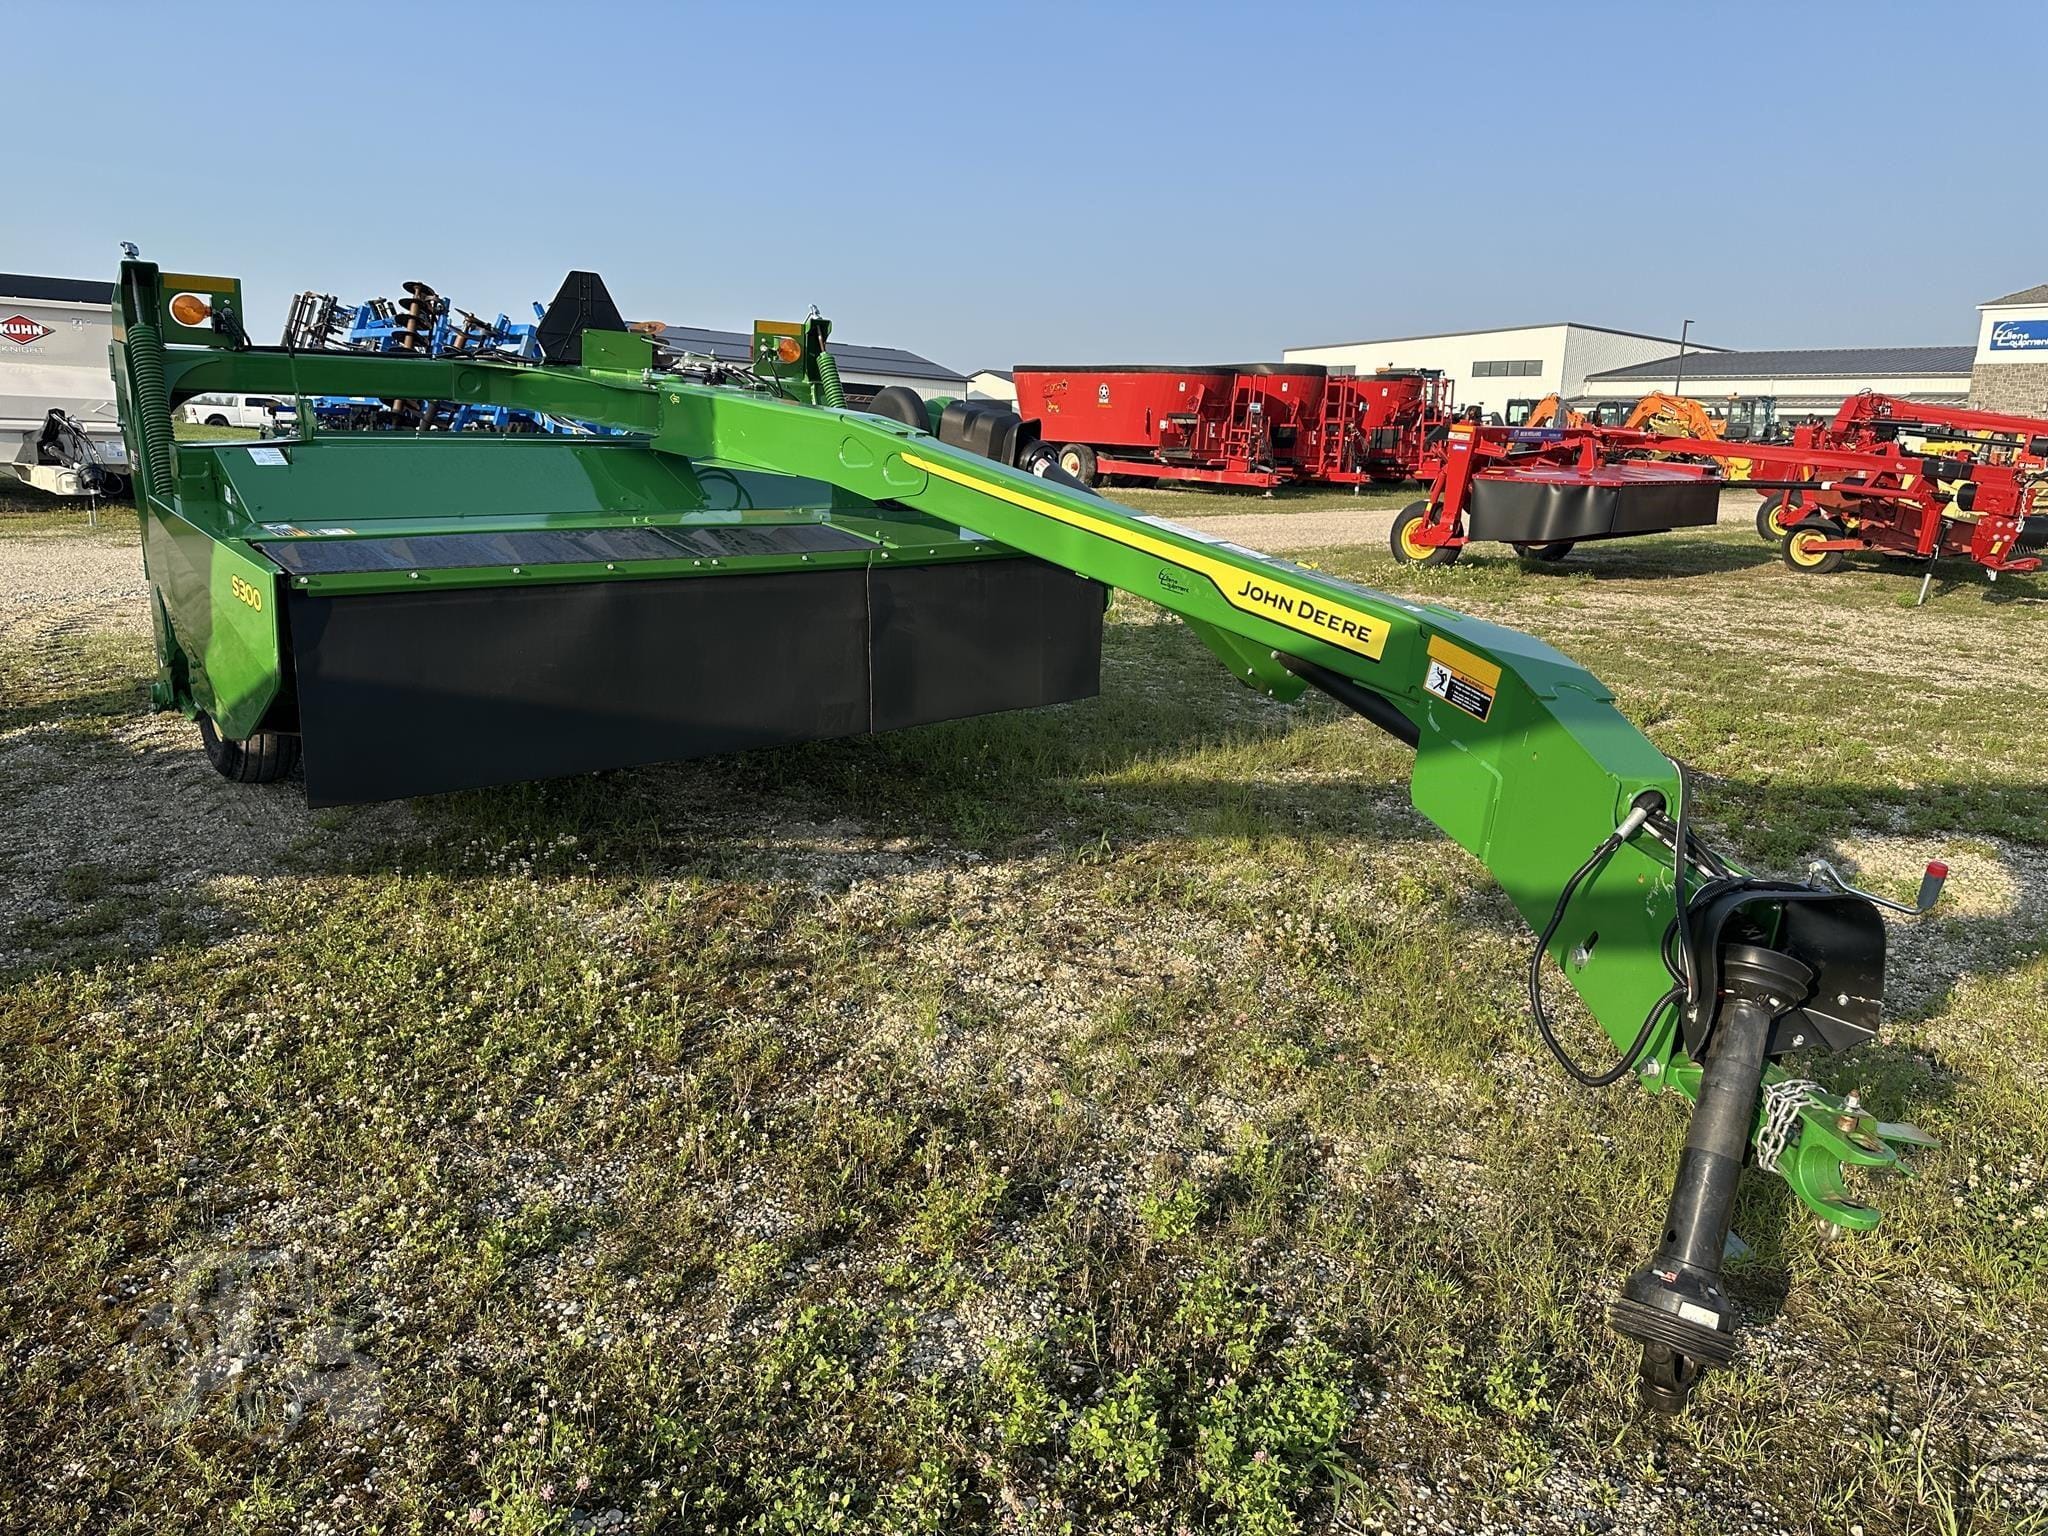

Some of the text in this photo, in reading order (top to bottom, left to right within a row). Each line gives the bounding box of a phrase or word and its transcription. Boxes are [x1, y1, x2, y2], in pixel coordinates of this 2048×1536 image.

[0, 323, 43, 335] KUHN
[1, 345, 45, 353] KNIGHT
[231, 573, 262, 613] S300
[1237, 580, 1294, 614] JOHN
[1297, 600, 1372, 643] DEERE
